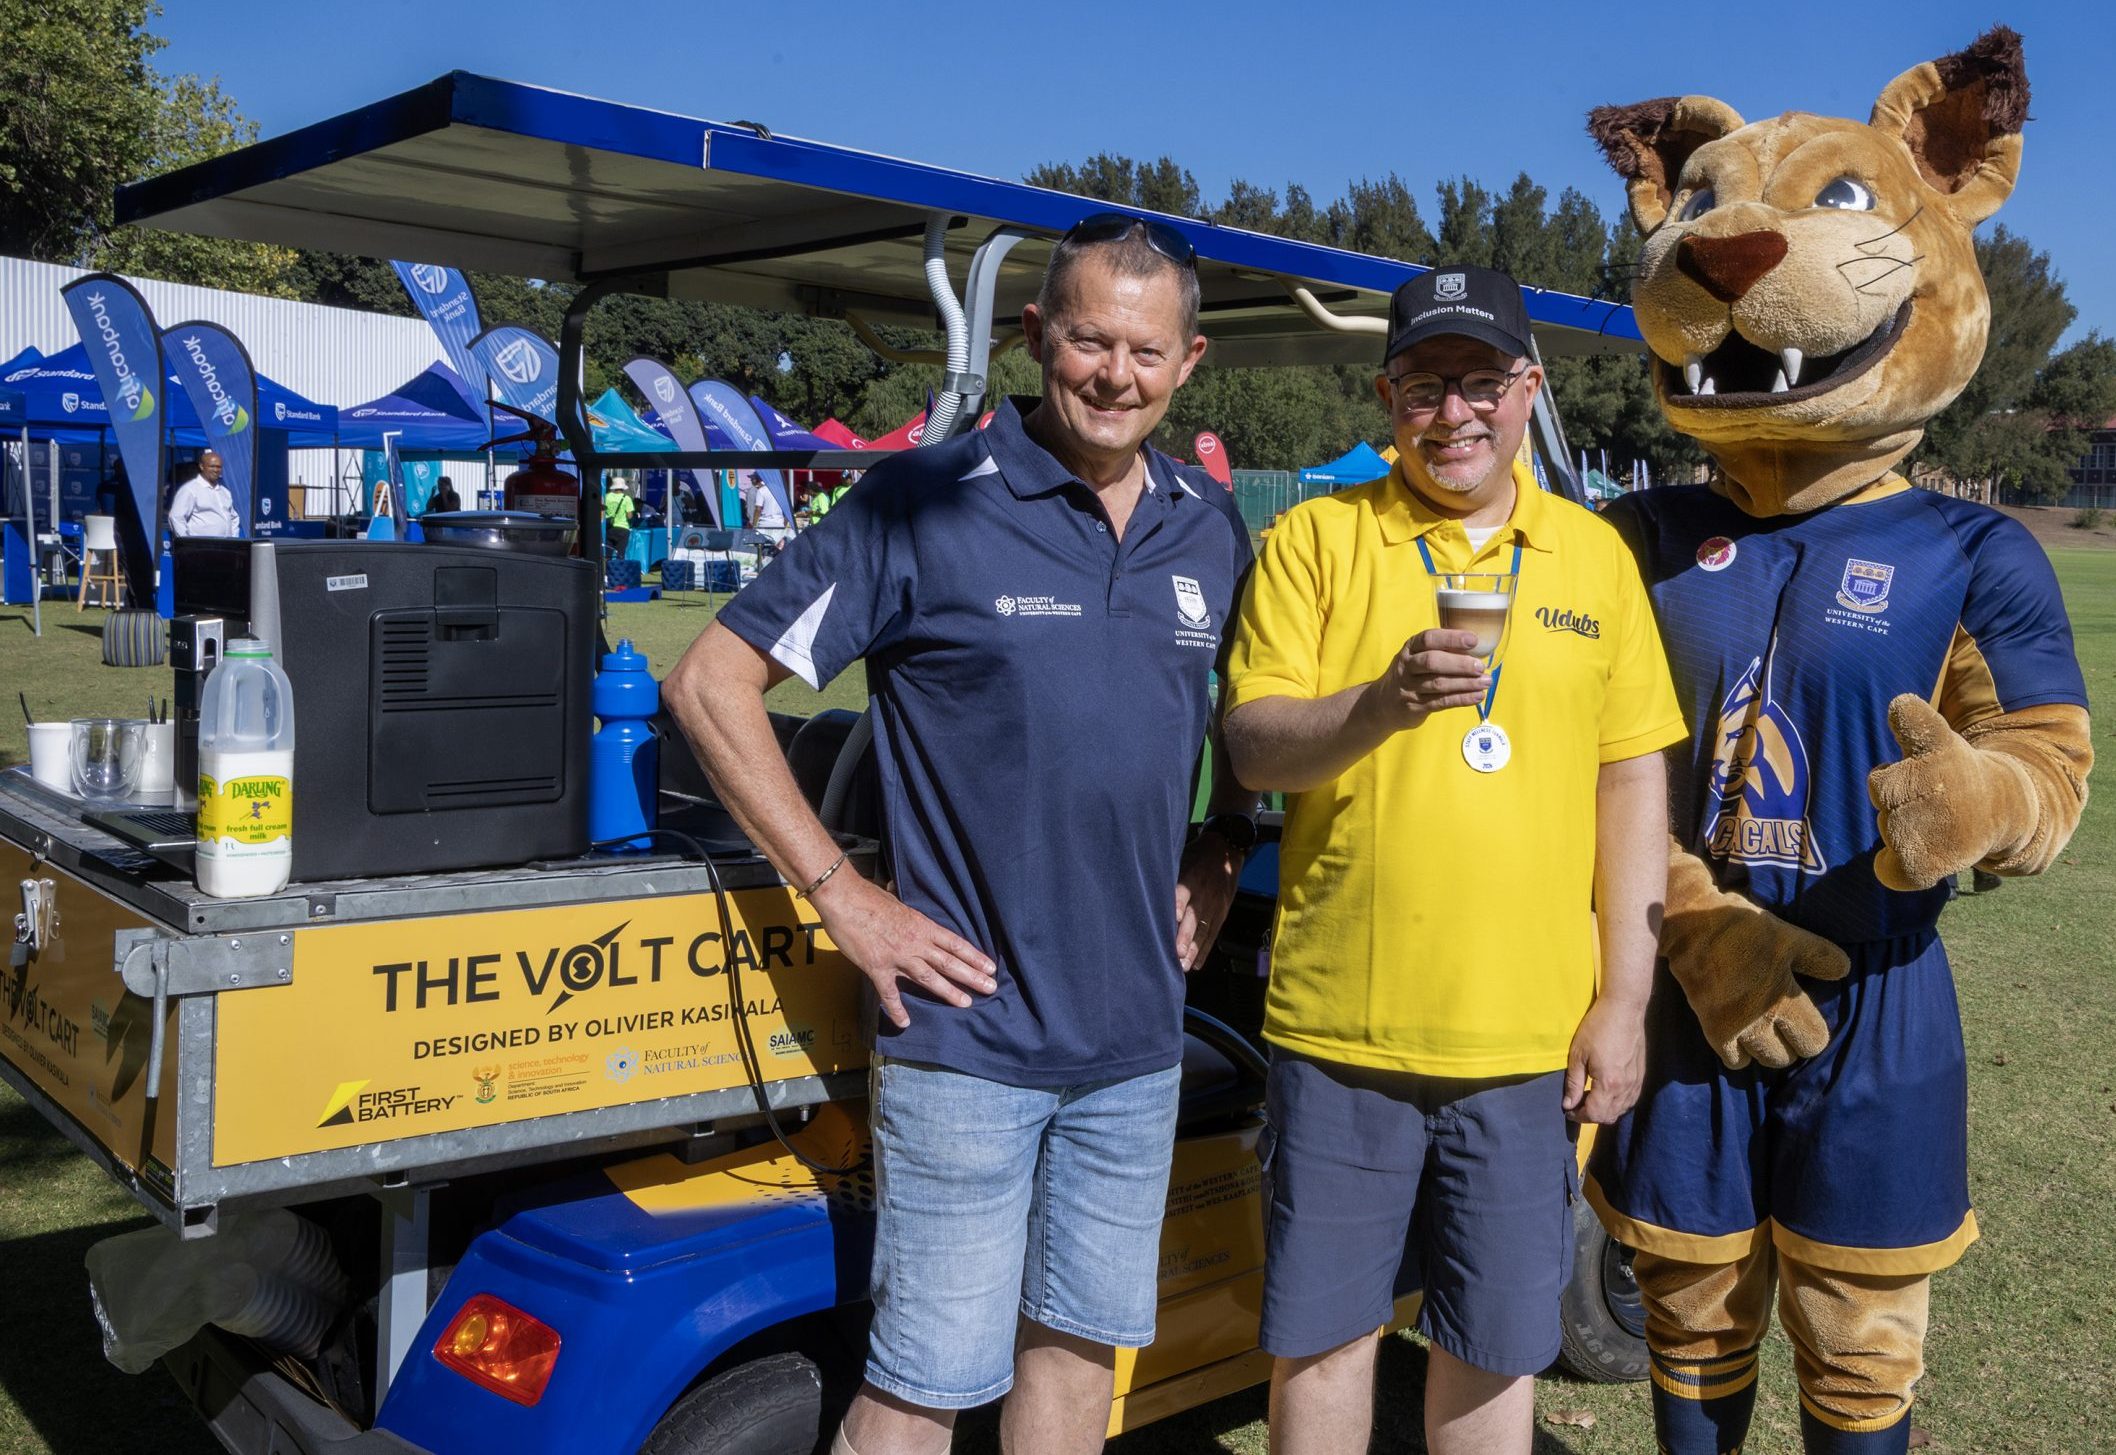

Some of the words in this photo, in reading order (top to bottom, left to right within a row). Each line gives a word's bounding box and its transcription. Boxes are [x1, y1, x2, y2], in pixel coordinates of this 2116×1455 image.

[1410, 305, 1454, 326] Inclusion
[1455, 305, 1495, 321] Matters
[1016, 596, 1048, 604] FACULTY
[1535, 607, 1600, 635] Udubs
[1826, 608, 1876, 623] UNIVERSITY
[1175, 630, 1209, 640] UNIVERSITY
[1824, 616, 1865, 629] WESTERN
[1867, 625, 1889, 636] CAPE
[1175, 639, 1205, 647] WESTERN
[231, 781, 281, 799] DARLING
[249, 832, 267, 840] milk
[265, 823, 288, 831] cream
[373, 953, 501, 1013] THE
[516, 934, 674, 999] VOLT
[687, 921, 824, 977] CART
[48, 1007, 79, 1058] CART
[414, 1027, 540, 1060] DESIGNED
[548, 1022, 576, 1043] BY
[591, 1011, 674, 1038] OLIVIER
[769, 1030, 815, 1048] SAIAMC
[543, 1053, 590, 1066] technology
[644, 1045, 699, 1062] FACULTY
[700, 1041, 710, 1054] of
[644, 1058, 700, 1075] NATURAL
[702, 1051, 750, 1067] SCIENC
[508, 1072, 515, 1080] &
[516, 1066, 562, 1079] innovation
[359, 1087, 420, 1108] FIRST
[508, 1093, 533, 1101] REPUBLIC
[358, 1096, 456, 1122] BATTERY
[1182, 1249, 1231, 1273] SCIENCES
